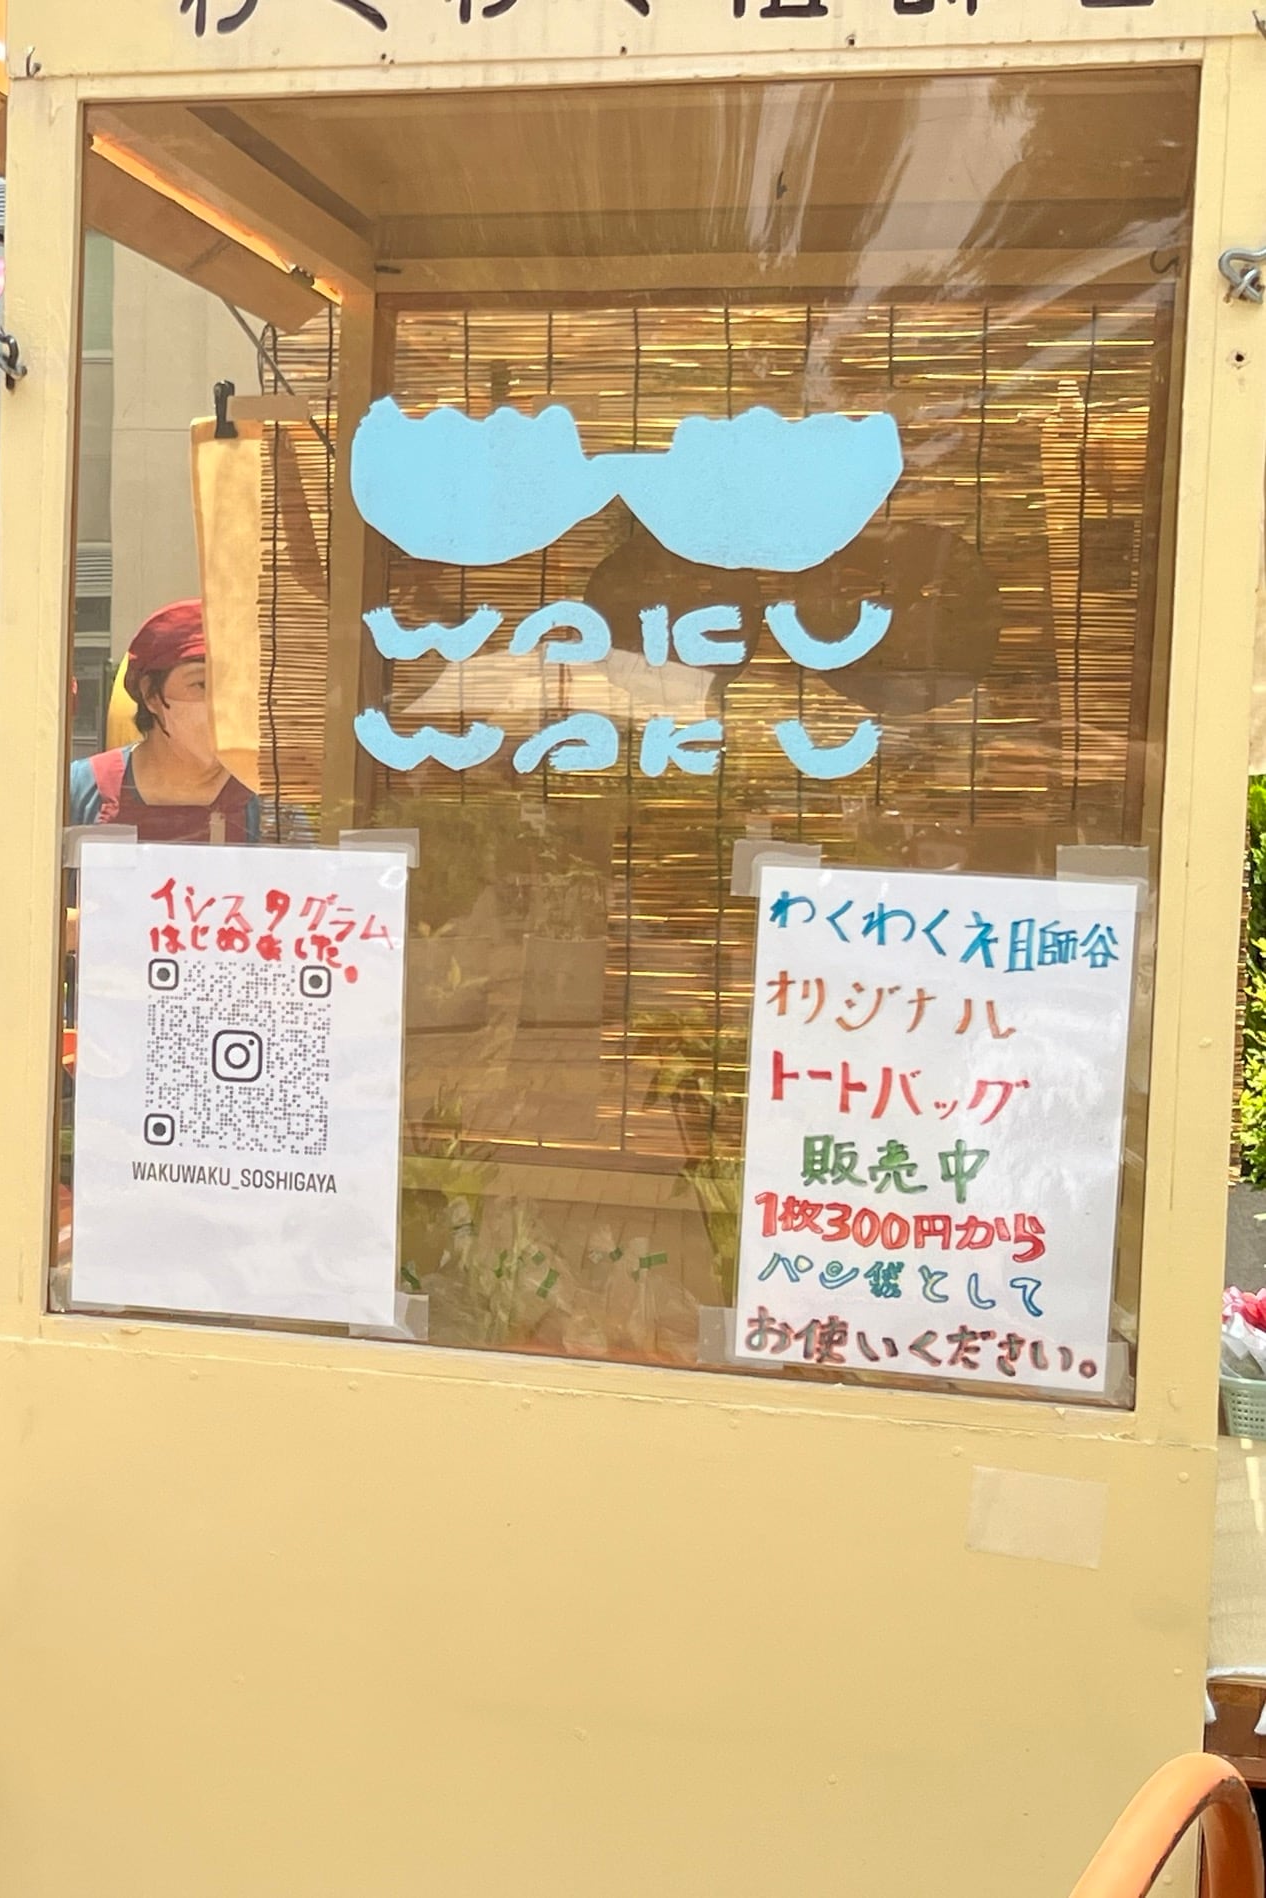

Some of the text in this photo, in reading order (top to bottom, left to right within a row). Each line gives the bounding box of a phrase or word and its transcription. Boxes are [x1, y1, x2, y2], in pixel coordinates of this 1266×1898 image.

[151, 877, 394, 950] インスタグラム
[769, 890, 1119, 974] わくわく祖師谷
[766, 970, 1016, 1039] オリジナル
[770, 1050, 1030, 1126] トートバッグ
[132, 1160, 337, 1194] WAKUWAKU_SOSHIGAYA
[800, 1135, 990, 1204] 販売中
[754, 1191, 1046, 1264] 1枚300円から
